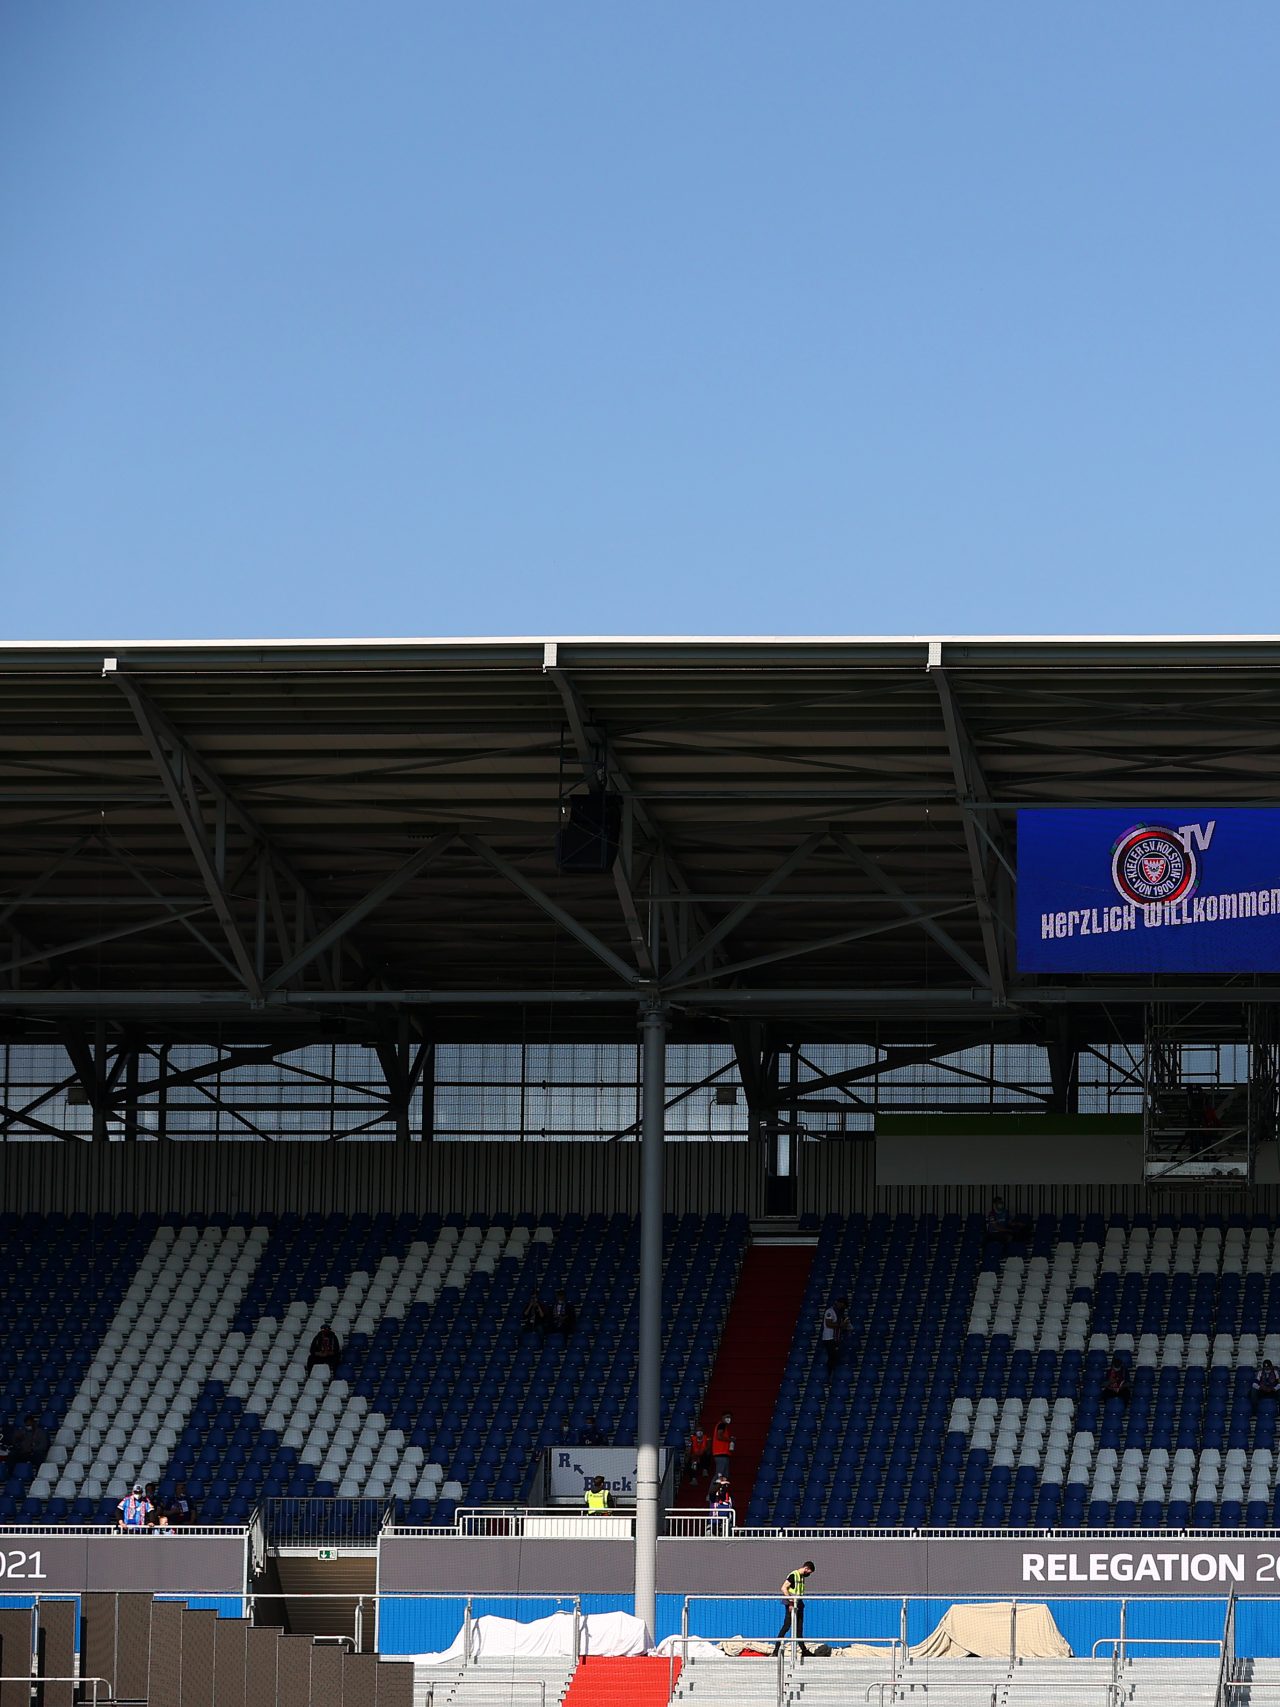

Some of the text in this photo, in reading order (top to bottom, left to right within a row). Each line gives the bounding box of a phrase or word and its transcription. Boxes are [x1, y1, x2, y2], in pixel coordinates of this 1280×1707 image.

[1179, 821, 1216, 853] TV
[1127, 846, 1145, 879] KIELER
[1157, 842, 1182, 879] HOLSTEIN
[1133, 879, 1175, 896] VON 1900
[558, 1453, 571, 1468] R
[583, 1477, 632, 1491] Bock
[1022, 1553, 1245, 1582] RELEGATION
